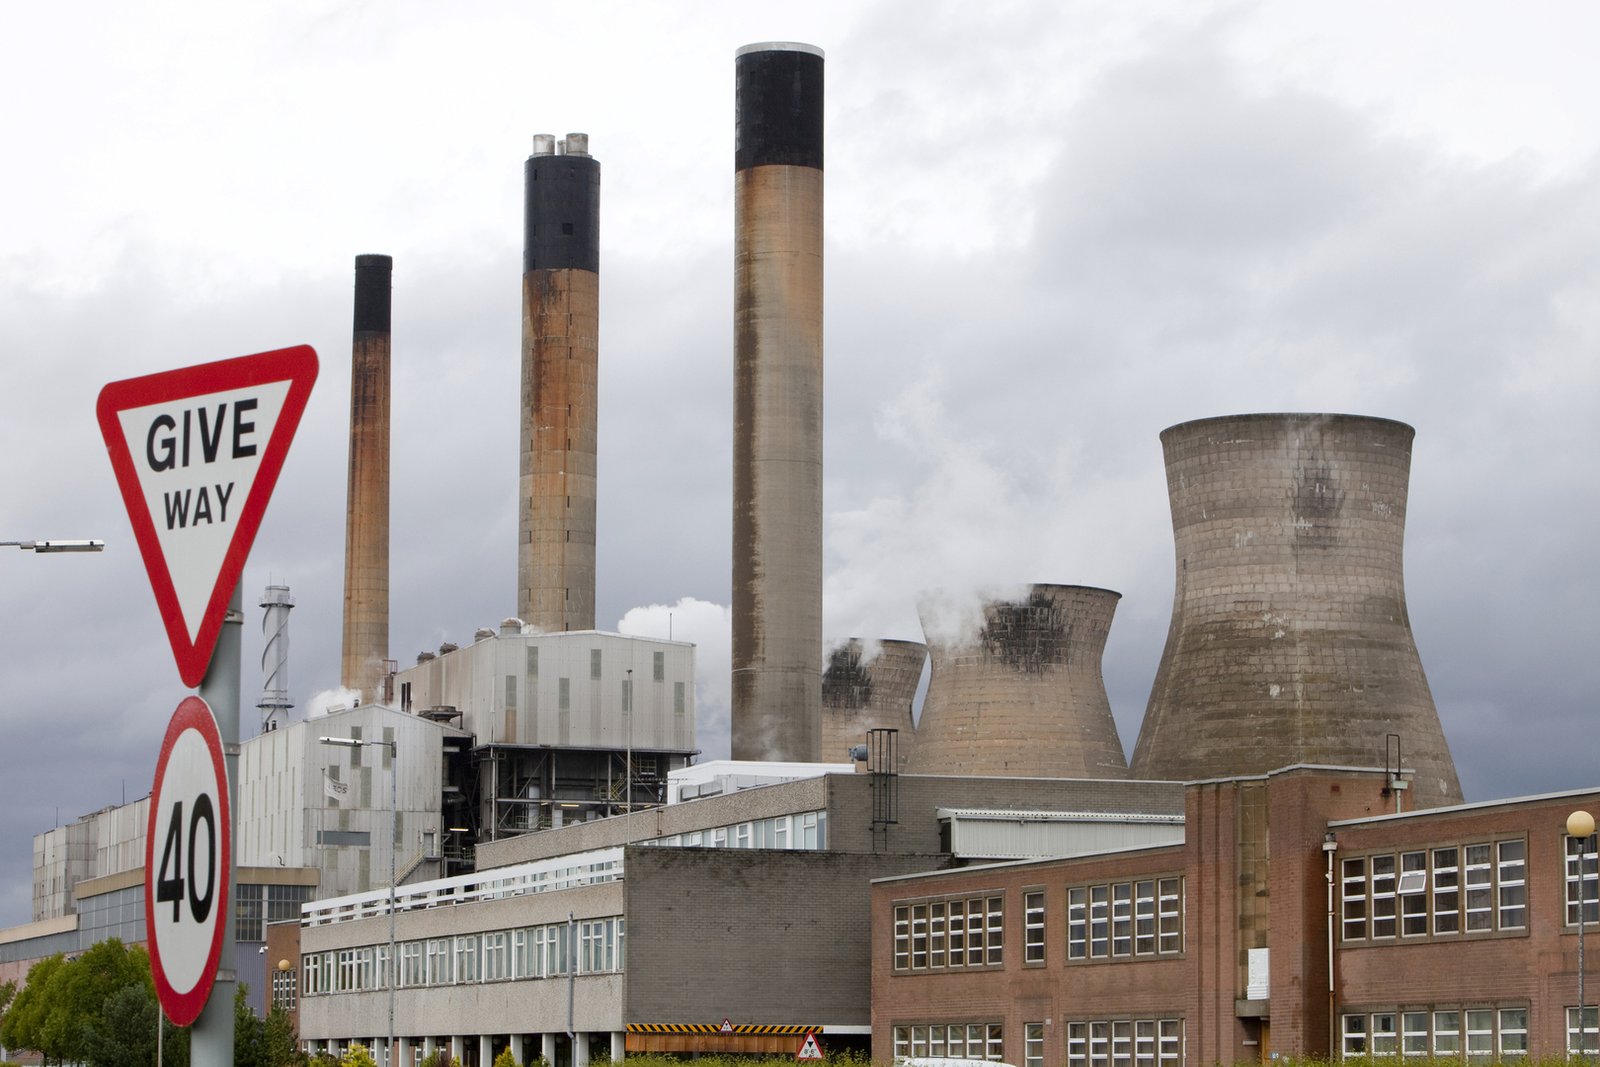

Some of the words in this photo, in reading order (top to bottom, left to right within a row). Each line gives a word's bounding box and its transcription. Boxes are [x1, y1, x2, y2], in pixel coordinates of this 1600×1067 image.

[146, 398, 258, 473] GIVE
[164, 482, 235, 530] WAY
[157, 793, 216, 923] 40
